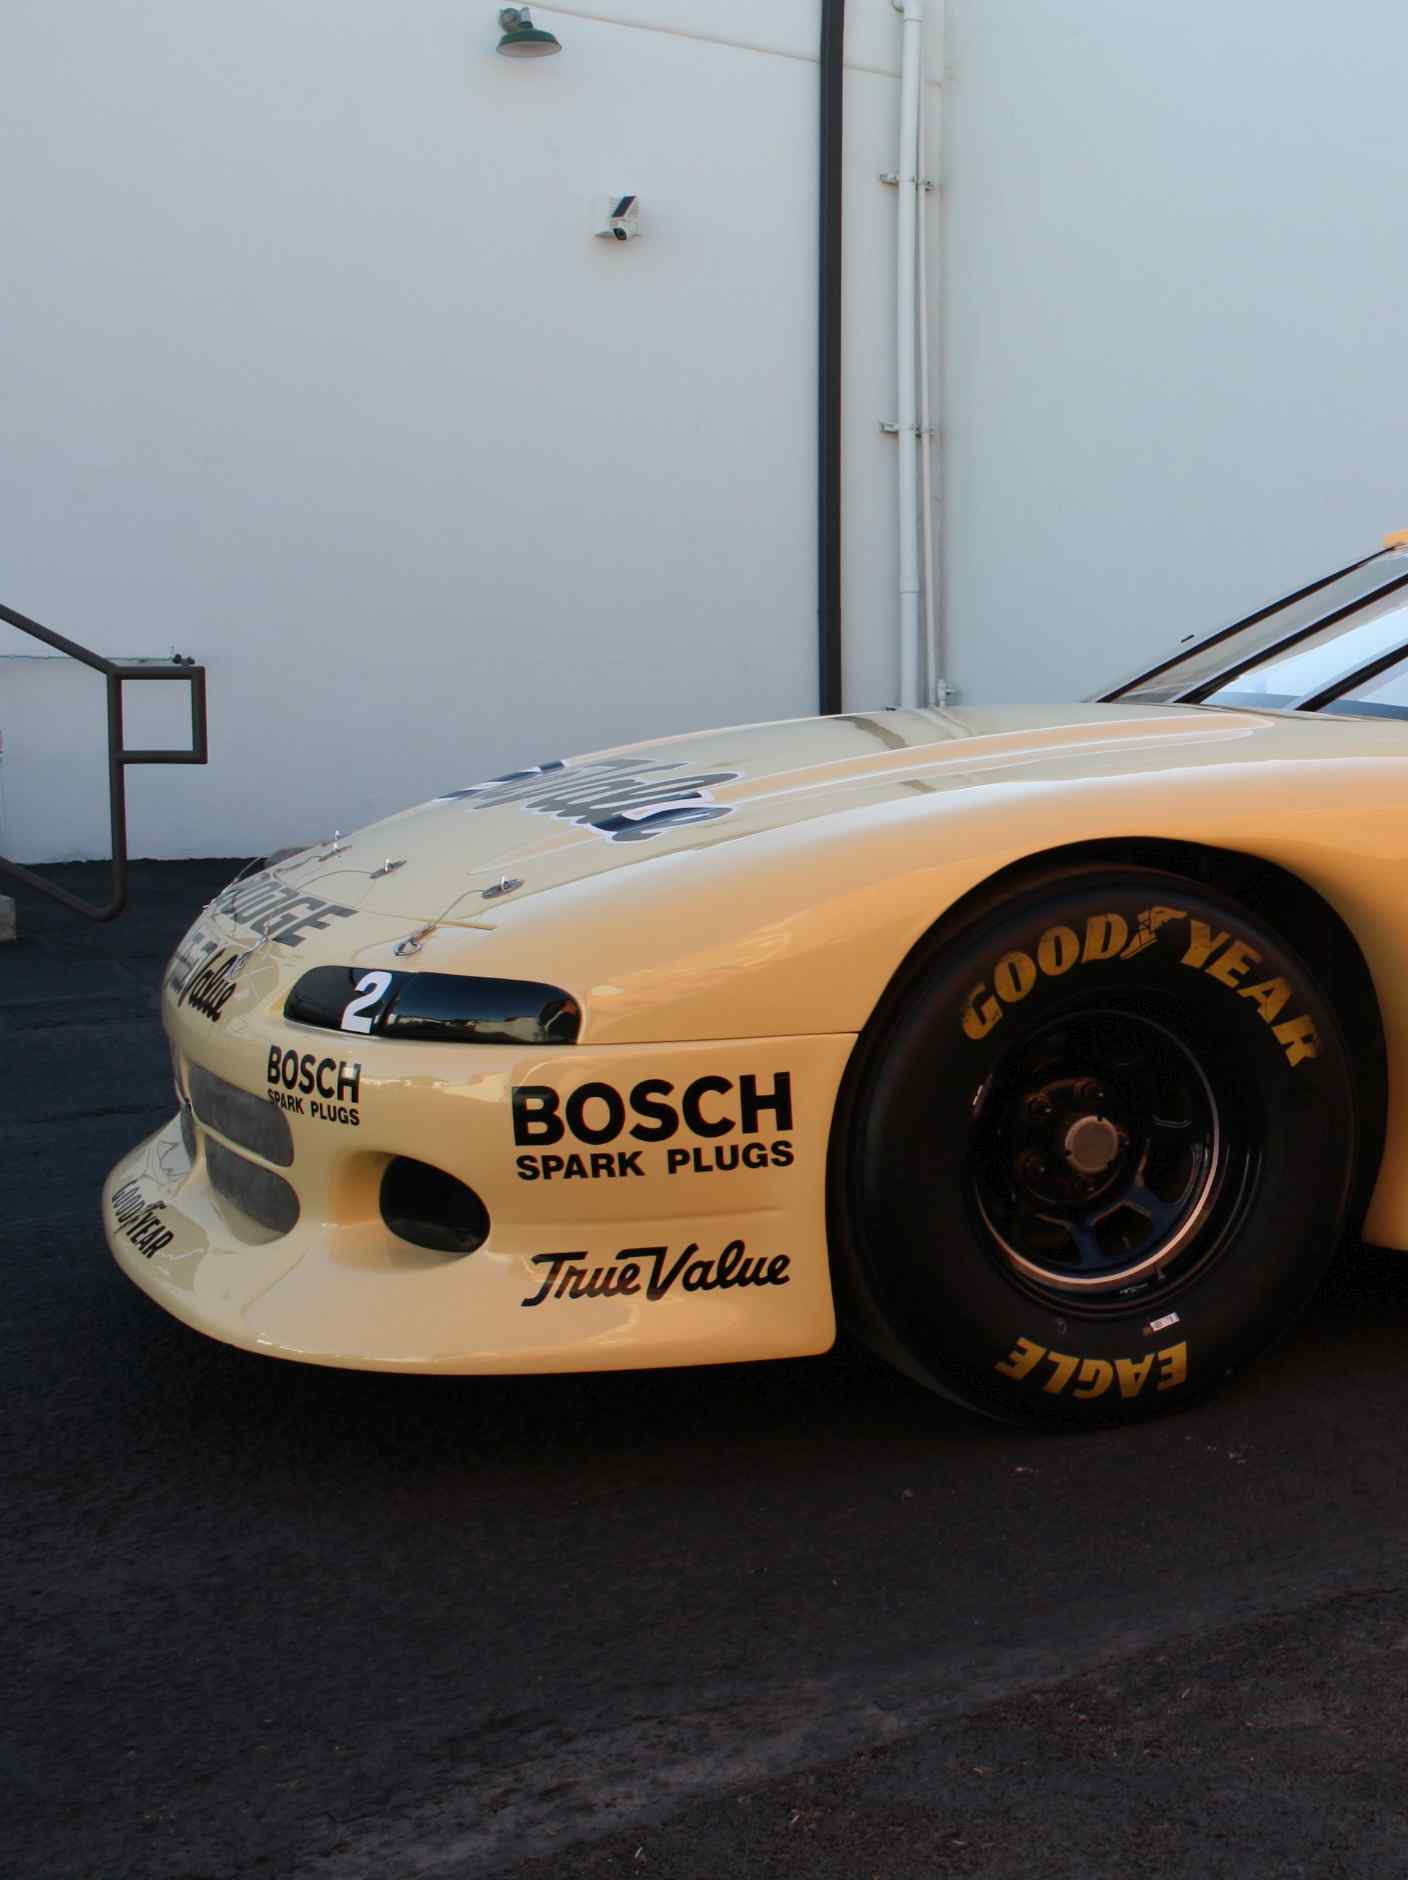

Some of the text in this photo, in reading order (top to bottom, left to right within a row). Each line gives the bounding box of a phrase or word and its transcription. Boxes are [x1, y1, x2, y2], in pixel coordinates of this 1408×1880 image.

[340, 971, 393, 1034] 2
[267, 1044, 361, 1104] BOSCH
[267, 1088, 361, 1126] SPARK PLUGS
[511, 1071, 793, 1146] BOSCH
[515, 1140, 794, 1181] SPARK PLUGS
[994, 1336, 1190, 1400] EAGLE
